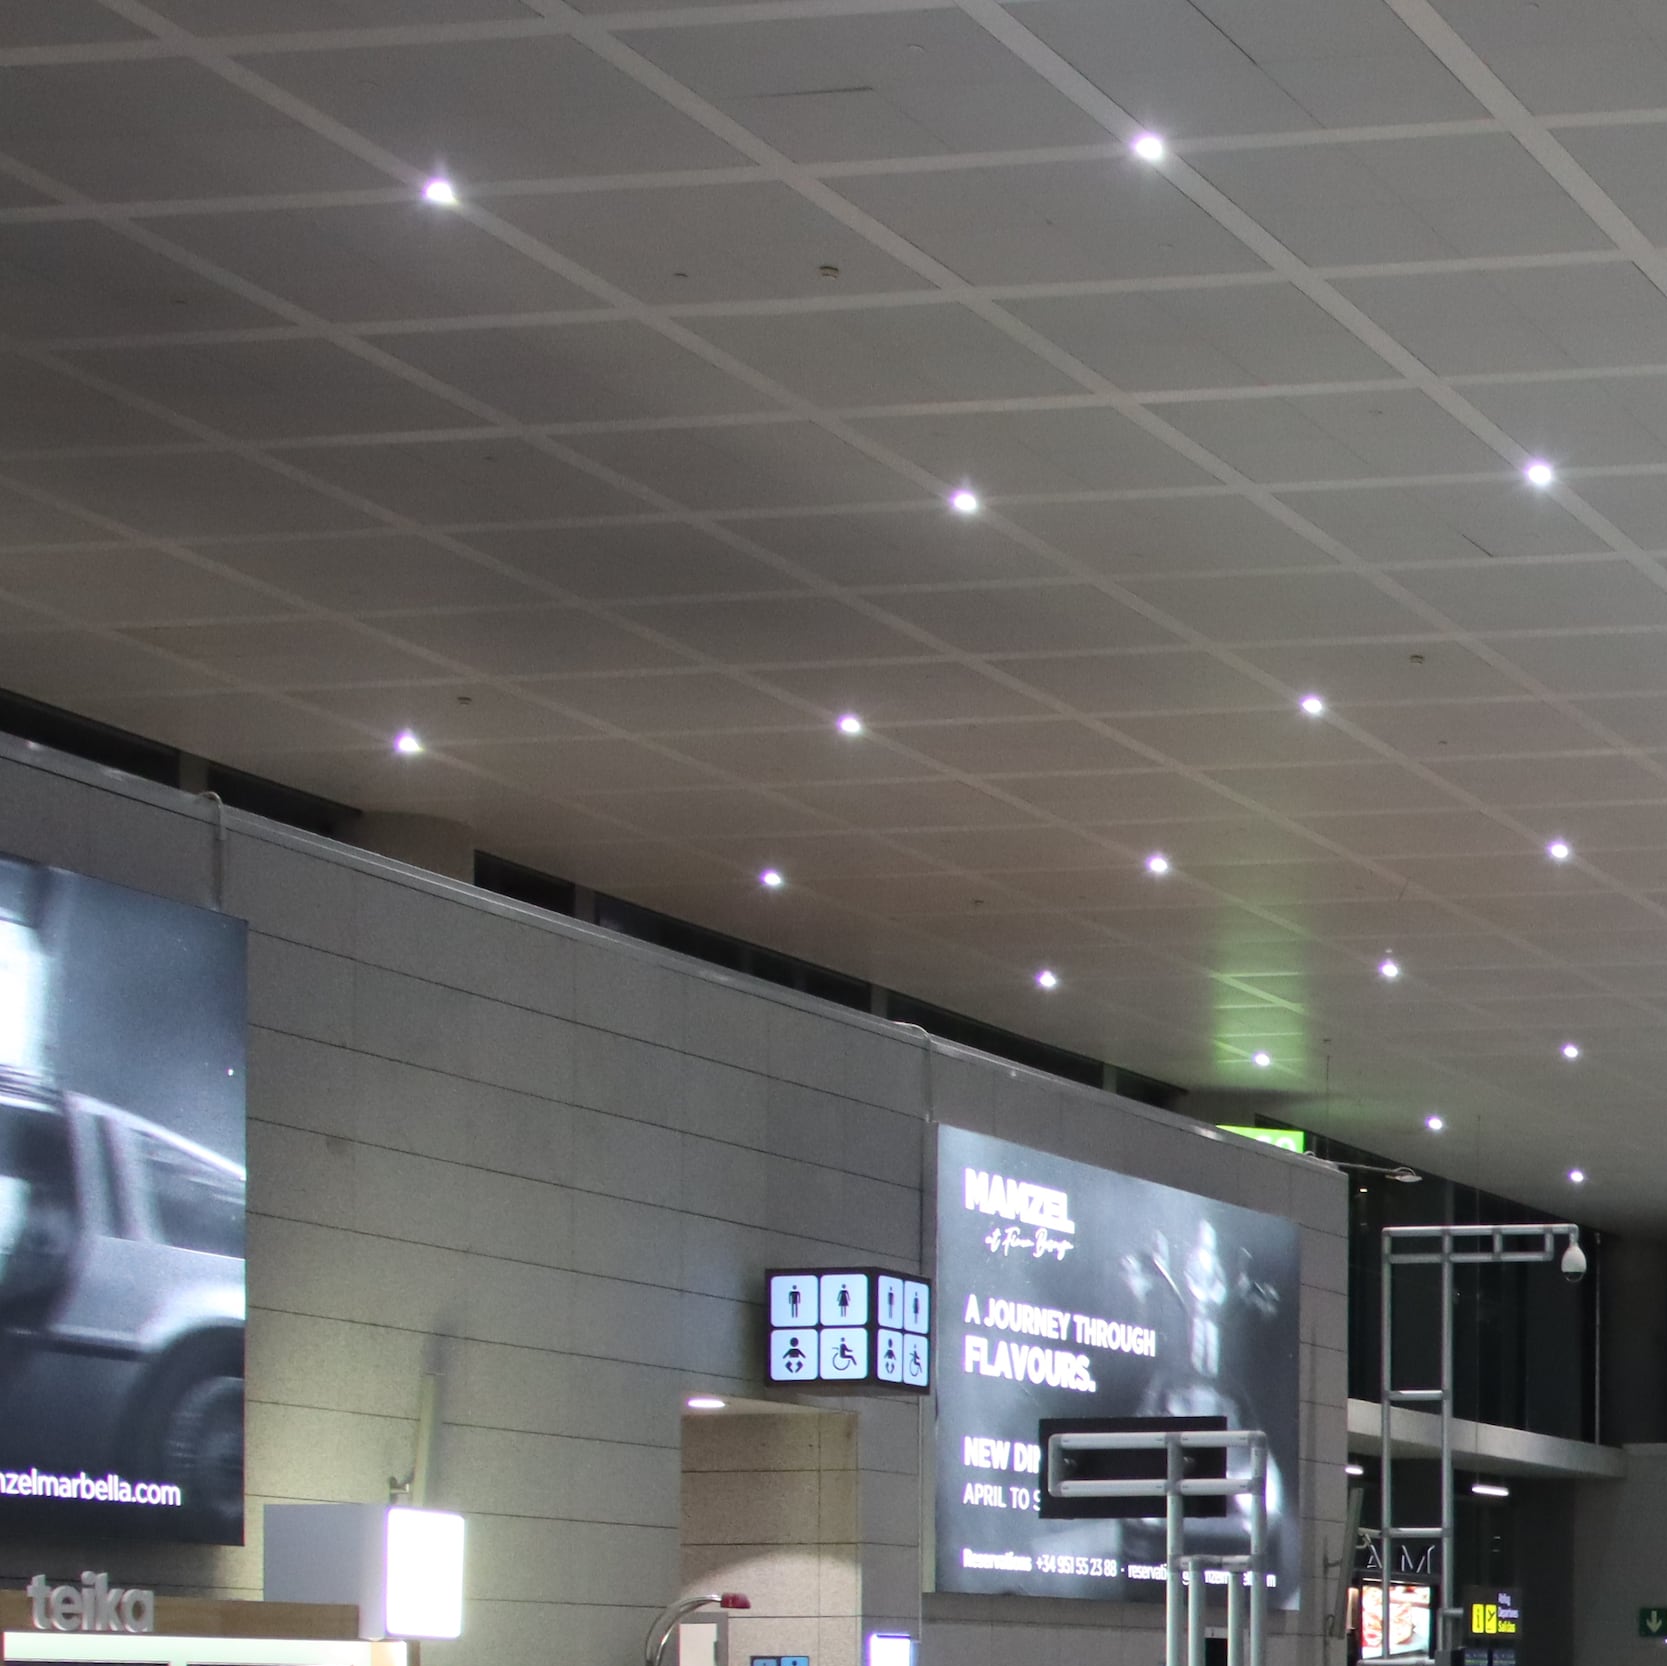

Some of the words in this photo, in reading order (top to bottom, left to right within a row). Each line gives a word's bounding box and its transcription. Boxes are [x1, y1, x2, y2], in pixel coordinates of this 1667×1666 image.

[964, 1293, 981, 1325] A
[983, 1297, 1071, 1341] JOURNEY
[1072, 1313, 1156, 1358] THROUGH
[964, 1335, 1097, 1393] FLAVOURS.
[964, 1436, 1011, 1470] NEW
[963, 1482, 1007, 1508] APRIL
[1010, 1487, 1030, 1510] TO
[962, 1548, 1033, 1572] Reservations
[1036, 1554, 1056, 1573] +34
[1057, 1555, 1074, 1575] 951
[1075, 1557, 1089, 1576] 55
[1090, 1557, 1103, 1577] 23
[26, 1570, 155, 1633] teika
